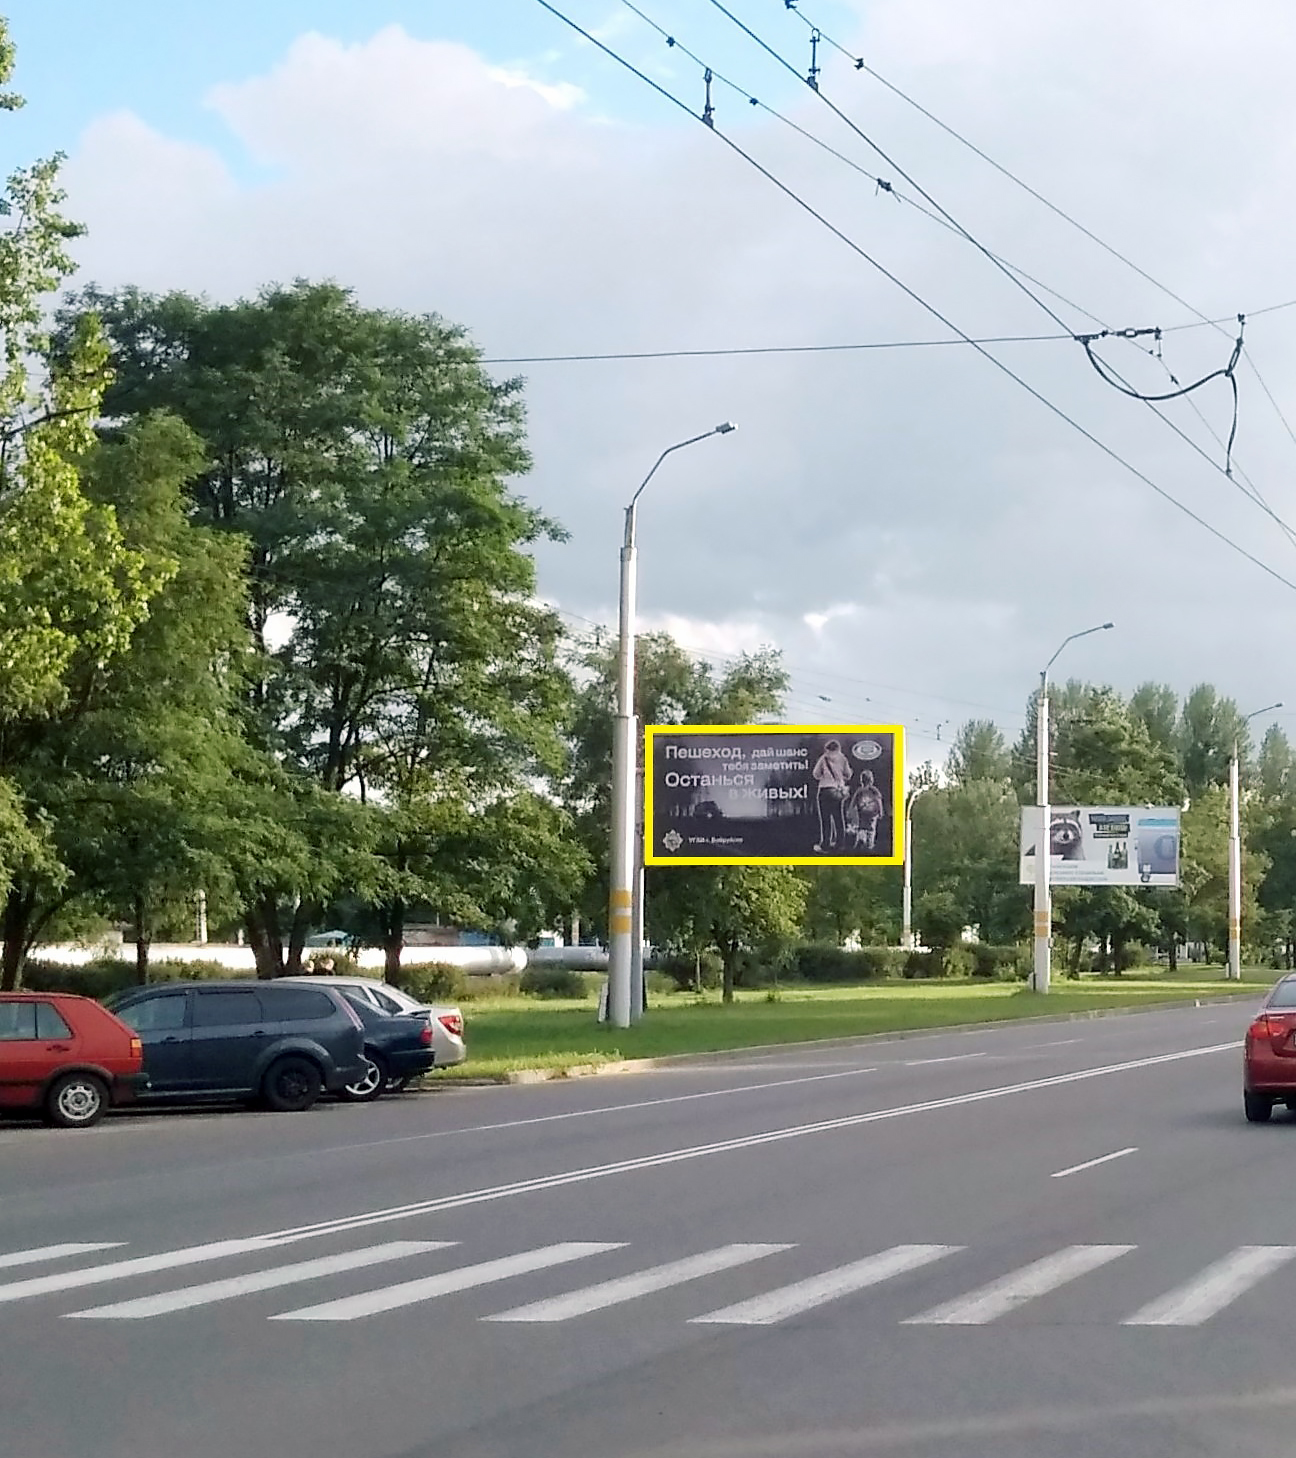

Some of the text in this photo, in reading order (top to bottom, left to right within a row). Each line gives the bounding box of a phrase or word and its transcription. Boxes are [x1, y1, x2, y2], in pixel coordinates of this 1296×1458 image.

[665, 745, 808, 760] Пешеход, дай шанс
[722, 760, 809, 771] тебя заметить!
[665, 771, 755, 787] Останься
[729, 784, 808, 799] в живых!
